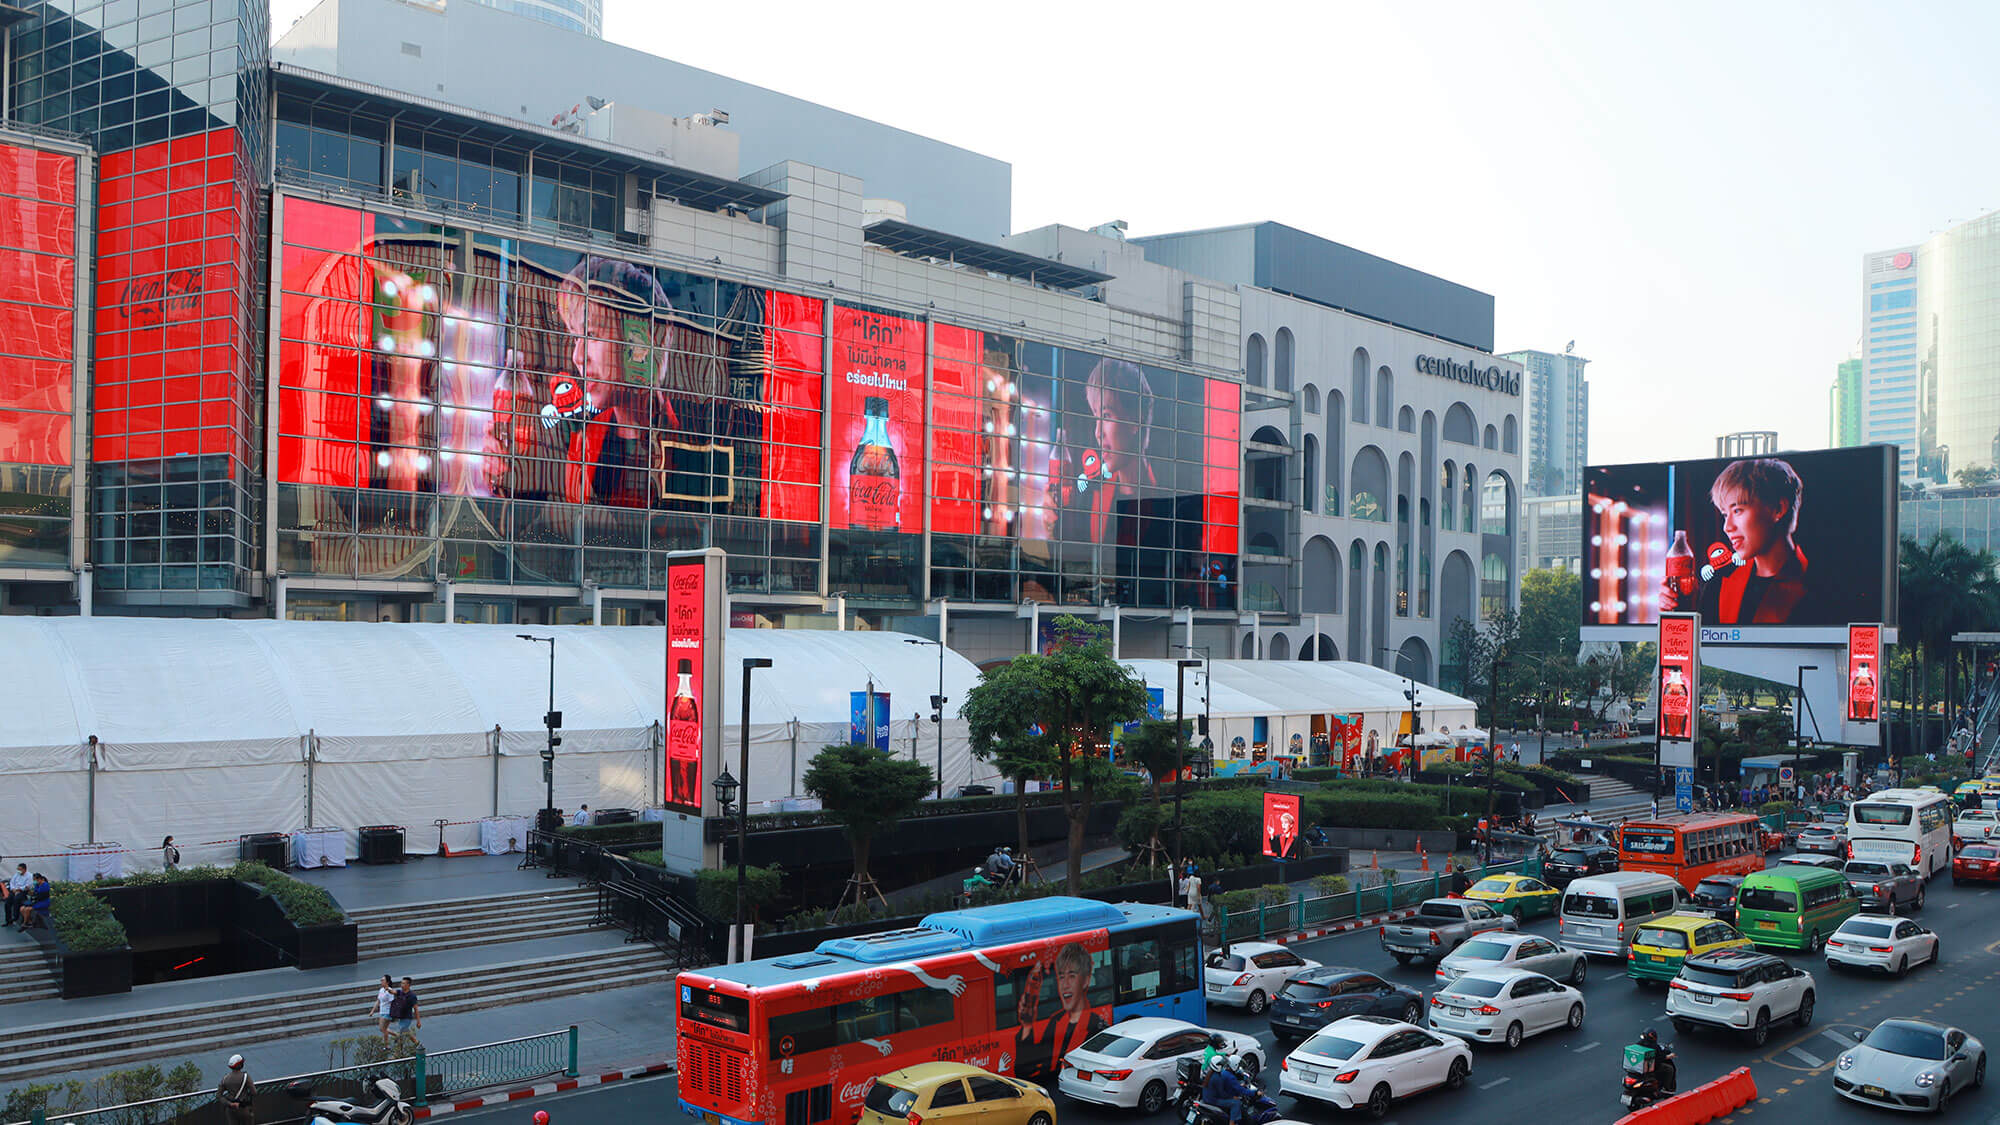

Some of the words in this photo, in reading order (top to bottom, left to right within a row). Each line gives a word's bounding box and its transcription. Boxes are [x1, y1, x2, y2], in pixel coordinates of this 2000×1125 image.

[120, 269, 203, 318] Coca-Cola
[847, 346, 906, 371] ไม่มีน้ำตาล
[846, 369, 907, 391] อร่อยไปไหน!
[852, 480, 896, 507] Coca-Cola
[673, 574, 699, 591] Coca-Cola
